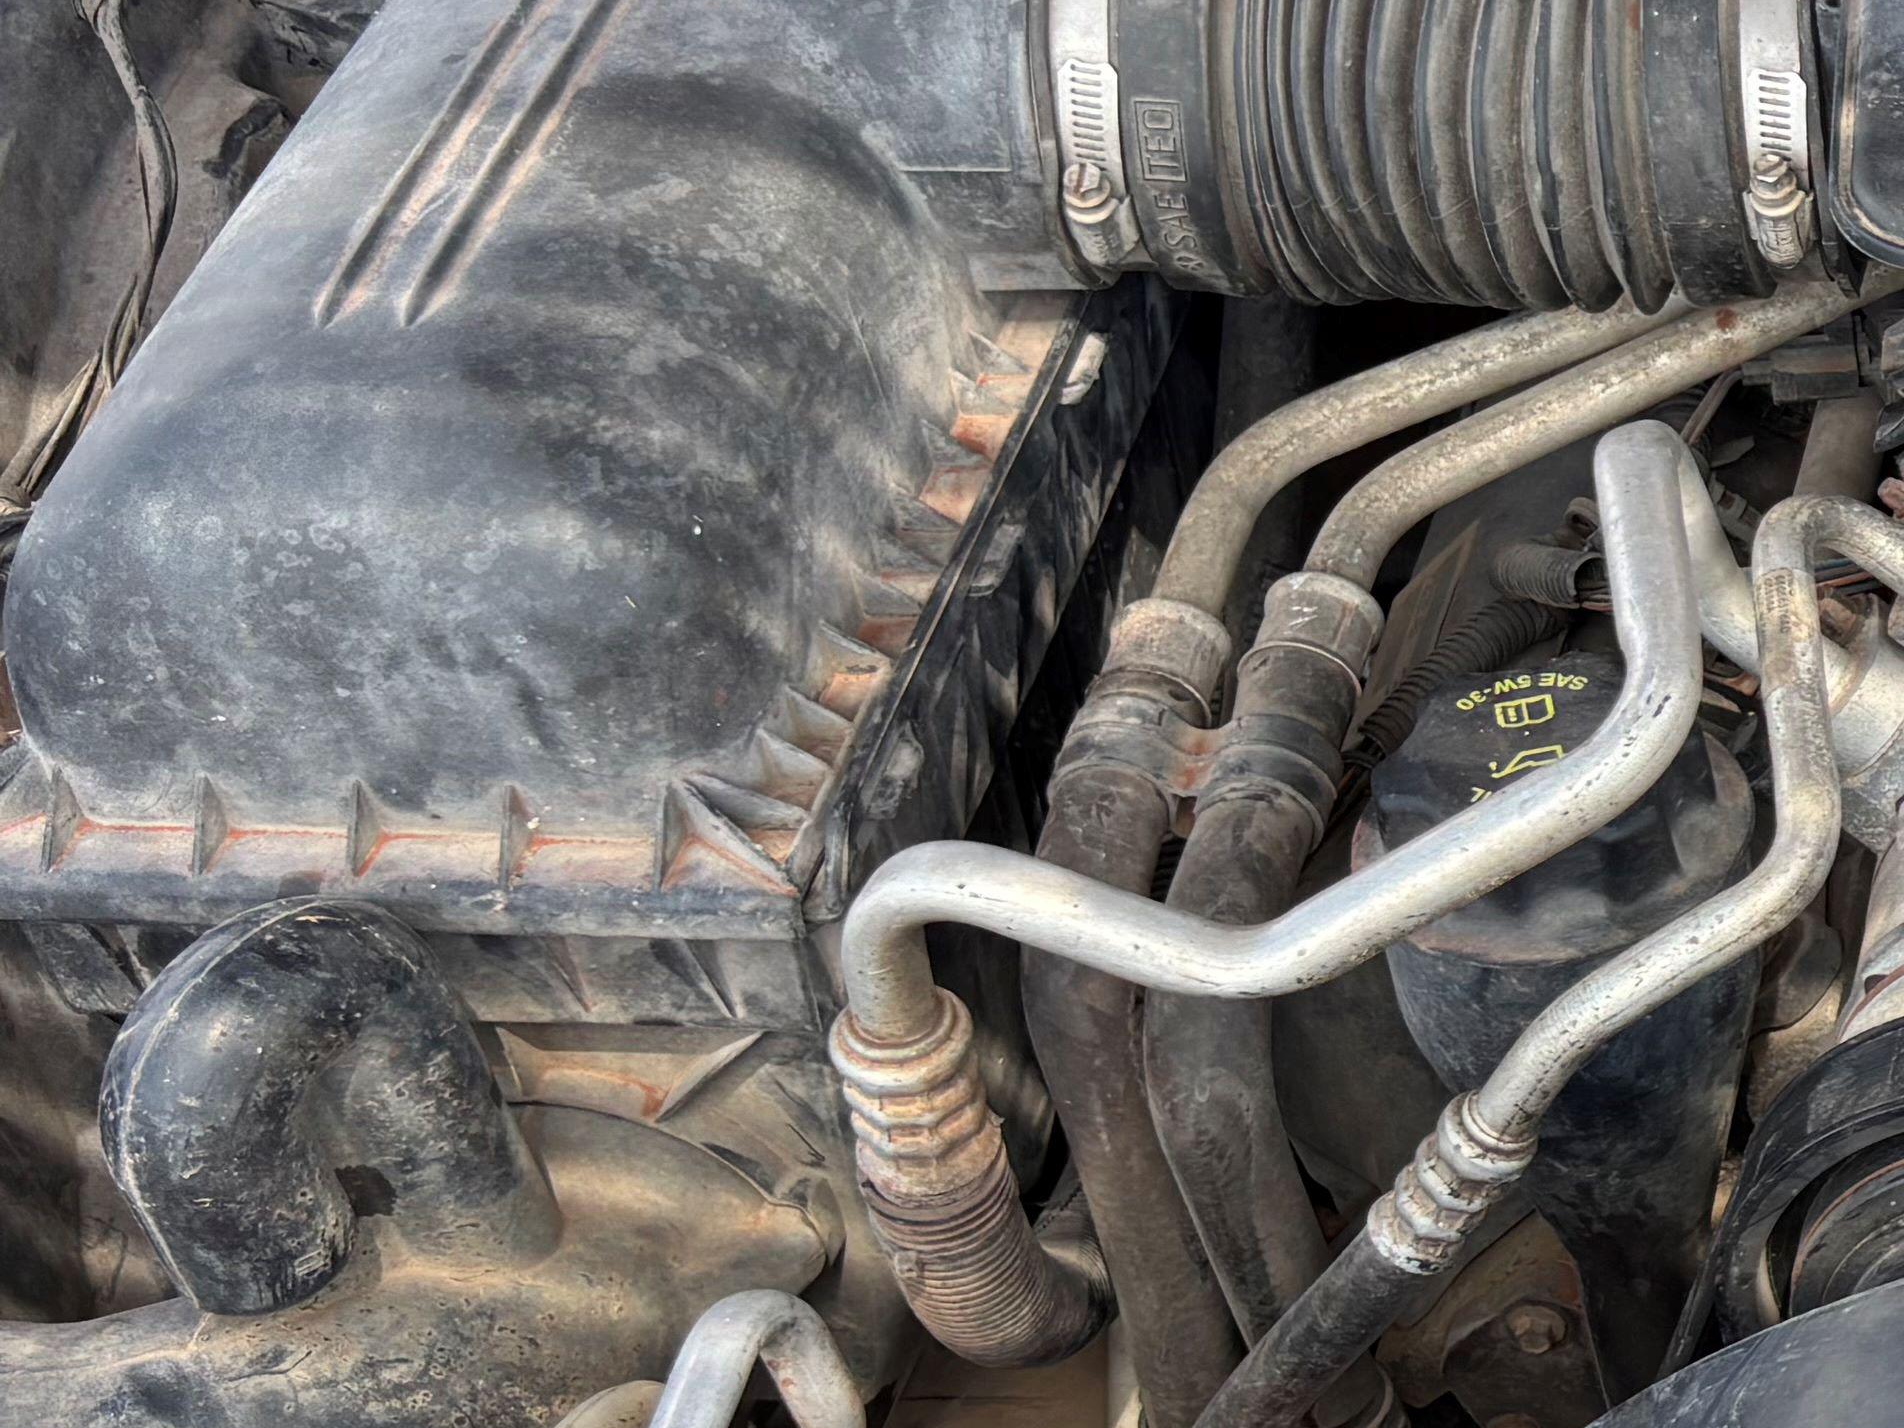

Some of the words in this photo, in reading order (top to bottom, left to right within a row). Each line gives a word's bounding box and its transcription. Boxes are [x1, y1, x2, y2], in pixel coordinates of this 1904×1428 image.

[1153, 193, 1198, 248] SAE
[1455, 674, 1530, 709] 5W-30
[1538, 672, 1587, 689] SAE
